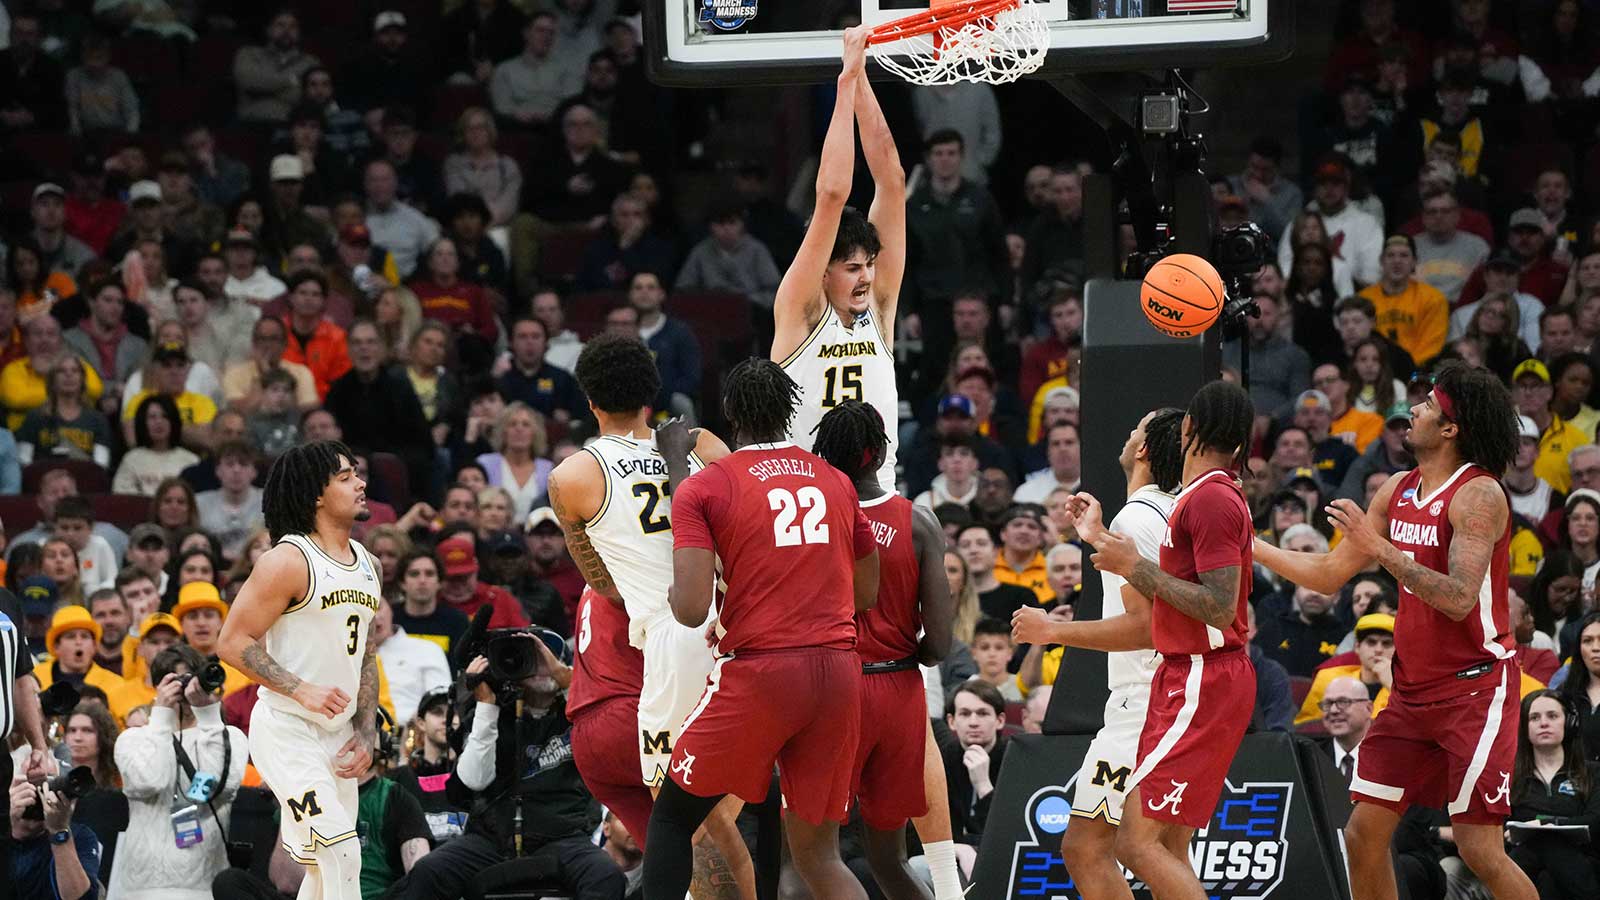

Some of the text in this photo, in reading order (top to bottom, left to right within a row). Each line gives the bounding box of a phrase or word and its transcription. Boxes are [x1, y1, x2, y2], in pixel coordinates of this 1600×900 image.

[716, 7, 756, 16] MADNESS
[1148, 297, 1184, 321] NCAA
[822, 364, 863, 407] 15
[748, 458, 815, 482] SHERRELL
[767, 486, 829, 547] 22
[1390, 518, 1439, 547] ALABAMA
[346, 614, 361, 655] 3
[579, 599, 591, 654] 3
[642, 729, 672, 755] M
[1091, 760, 1132, 793] M
[286, 789, 323, 823] M
